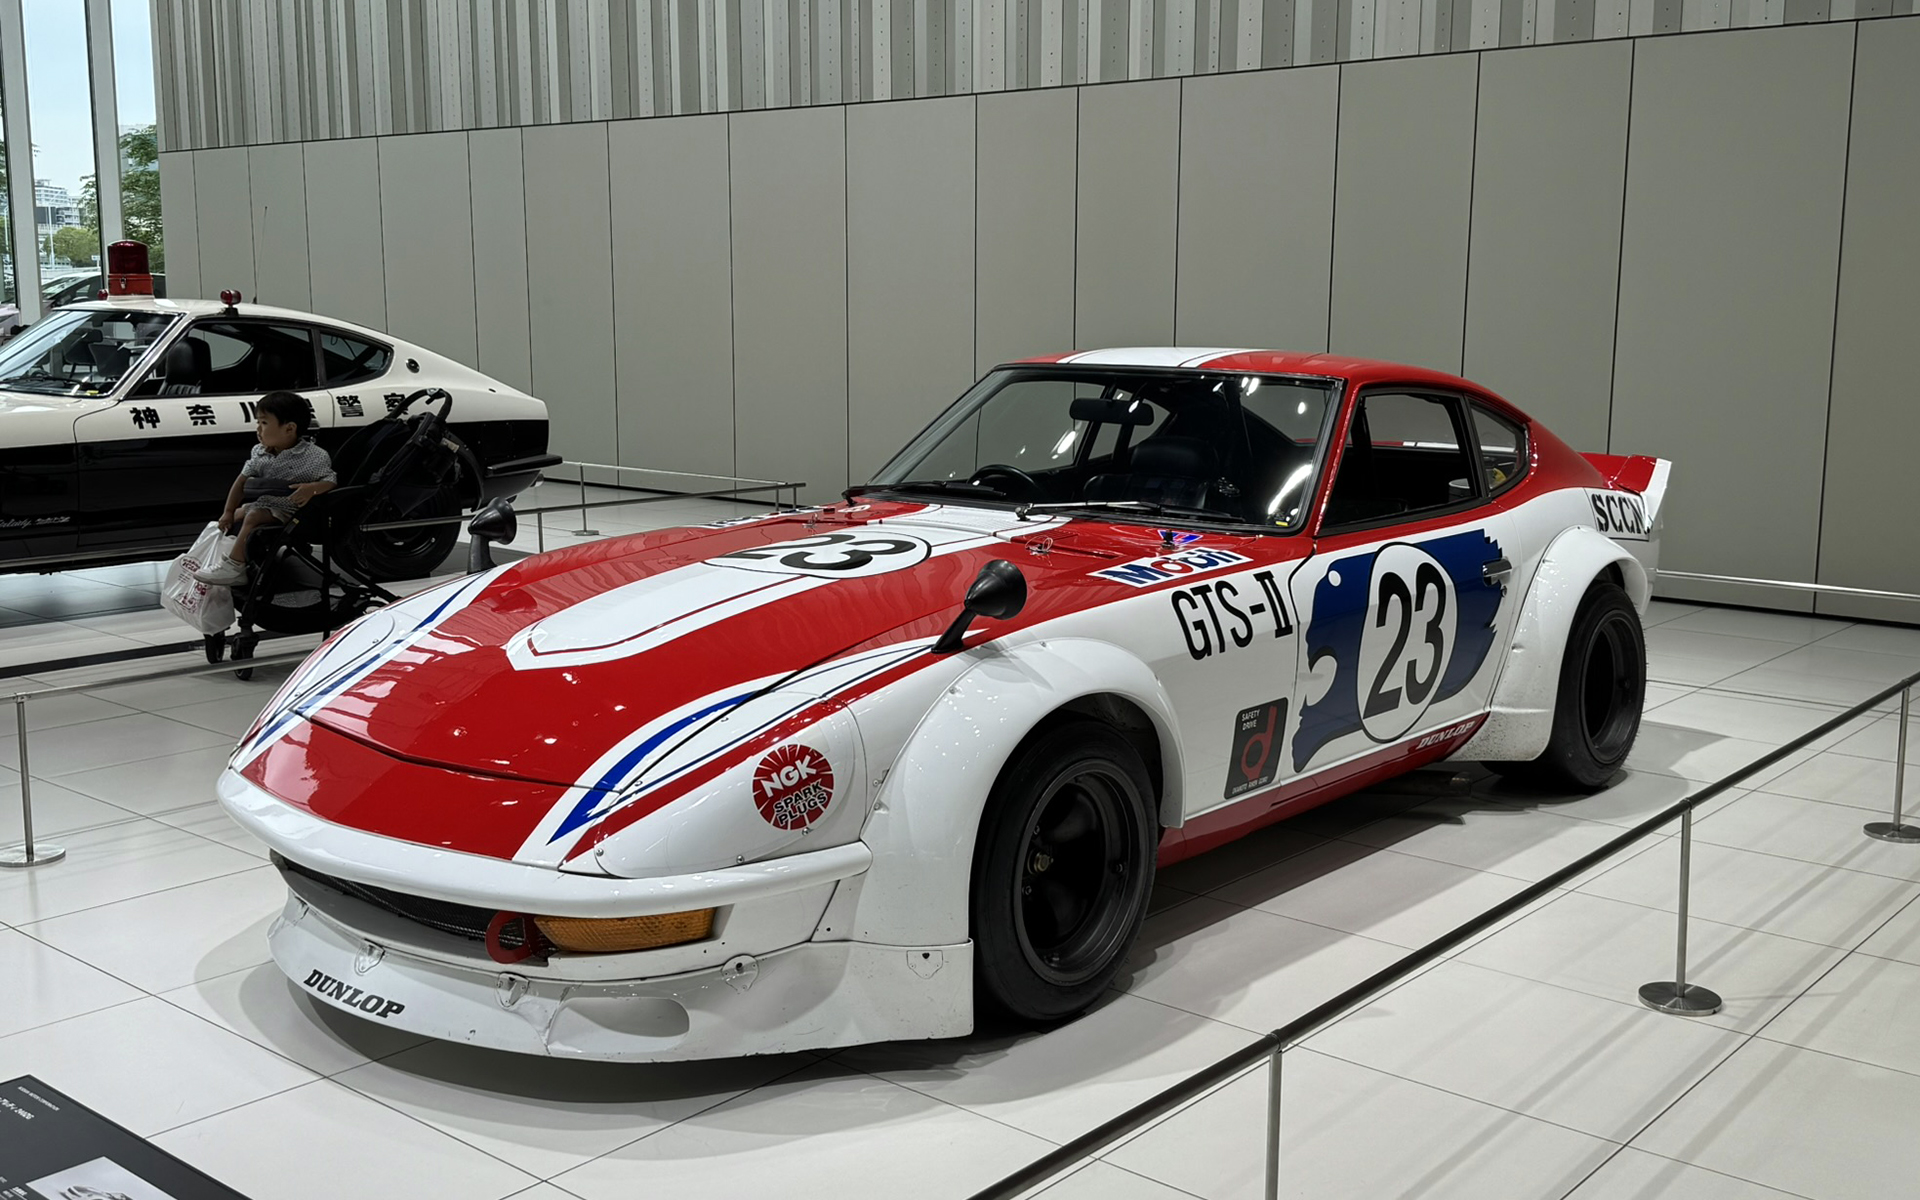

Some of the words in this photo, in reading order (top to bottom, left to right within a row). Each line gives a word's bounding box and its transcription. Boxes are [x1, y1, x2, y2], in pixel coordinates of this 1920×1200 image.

[1591, 493, 1651, 535] SCCN
[719, 533, 918, 571] 23
[1099, 548, 1242, 585] Mobil
[1362, 562, 1447, 720] 23
[1241, 709, 1260, 721] SAFETY
[1242, 720, 1257, 731] DRIVE
[1416, 721, 1475, 750] DUNLOP
[760, 754, 817, 798] NGK
[773, 780, 823, 813] SPARK
[777, 792, 828, 826] PLUGS
[303, 968, 406, 1019] DUNLOP
